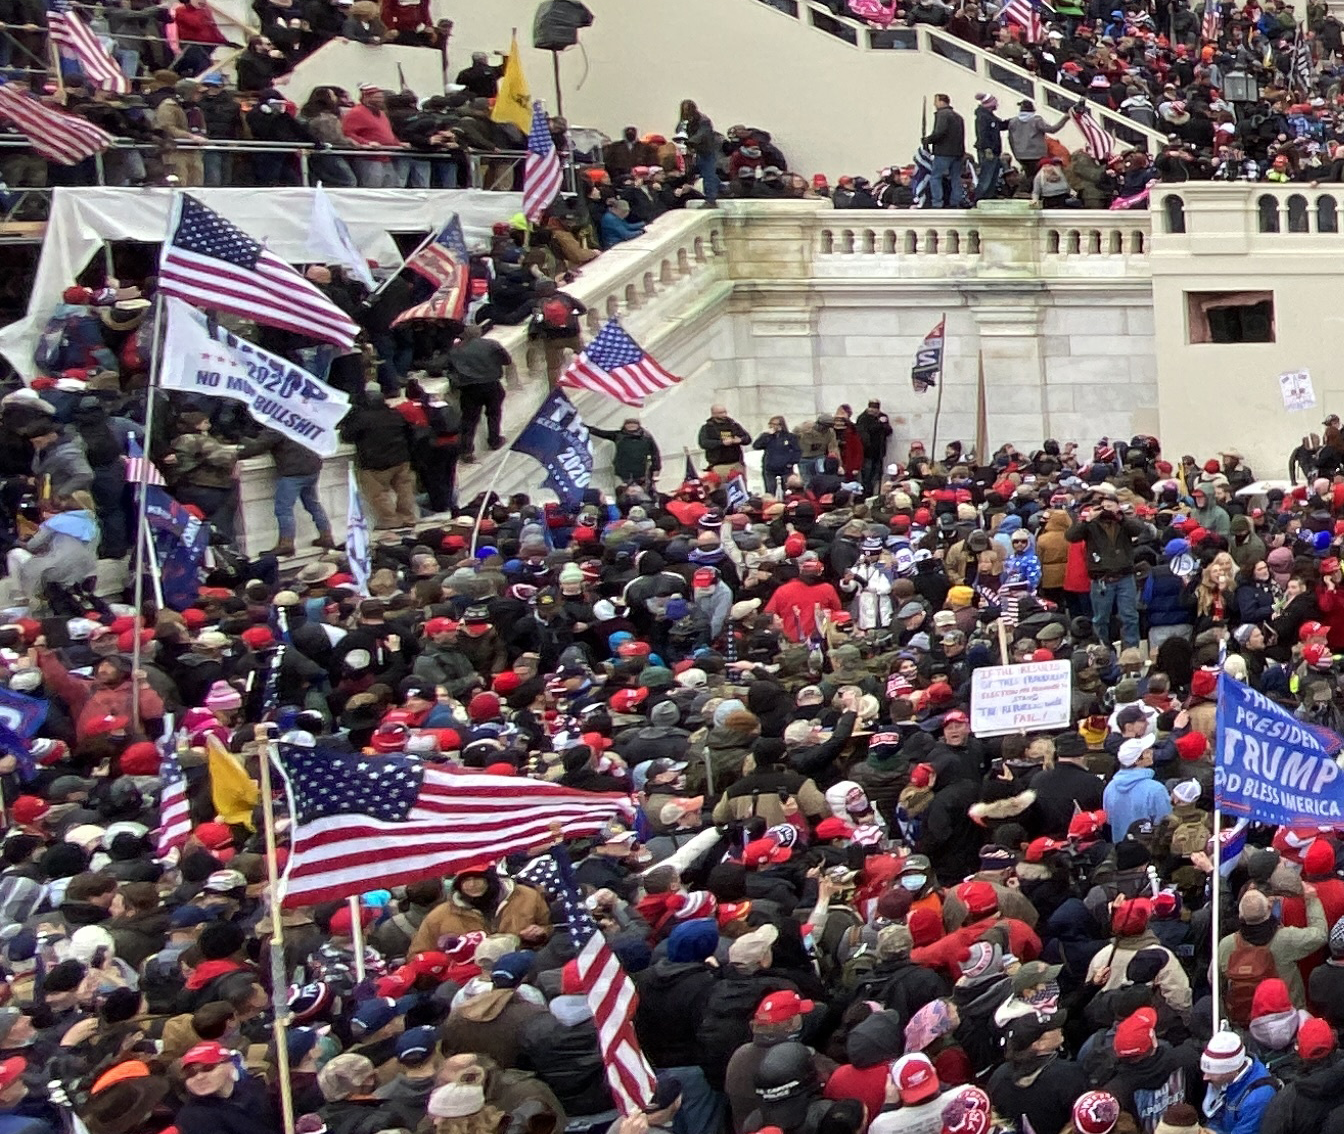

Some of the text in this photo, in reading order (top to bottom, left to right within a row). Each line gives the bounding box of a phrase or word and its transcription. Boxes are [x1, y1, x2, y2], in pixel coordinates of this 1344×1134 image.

[196, 370, 220, 387] NO
[253, 394, 326, 441] BULLSHIT
[556, 447, 592, 488] 2020
[980, 670, 994, 679] IF
[1236, 705, 1321, 752] PRESIDEN
[1224, 727, 1339, 793] TRUMP
[1242, 777, 1280, 806] BLESS
